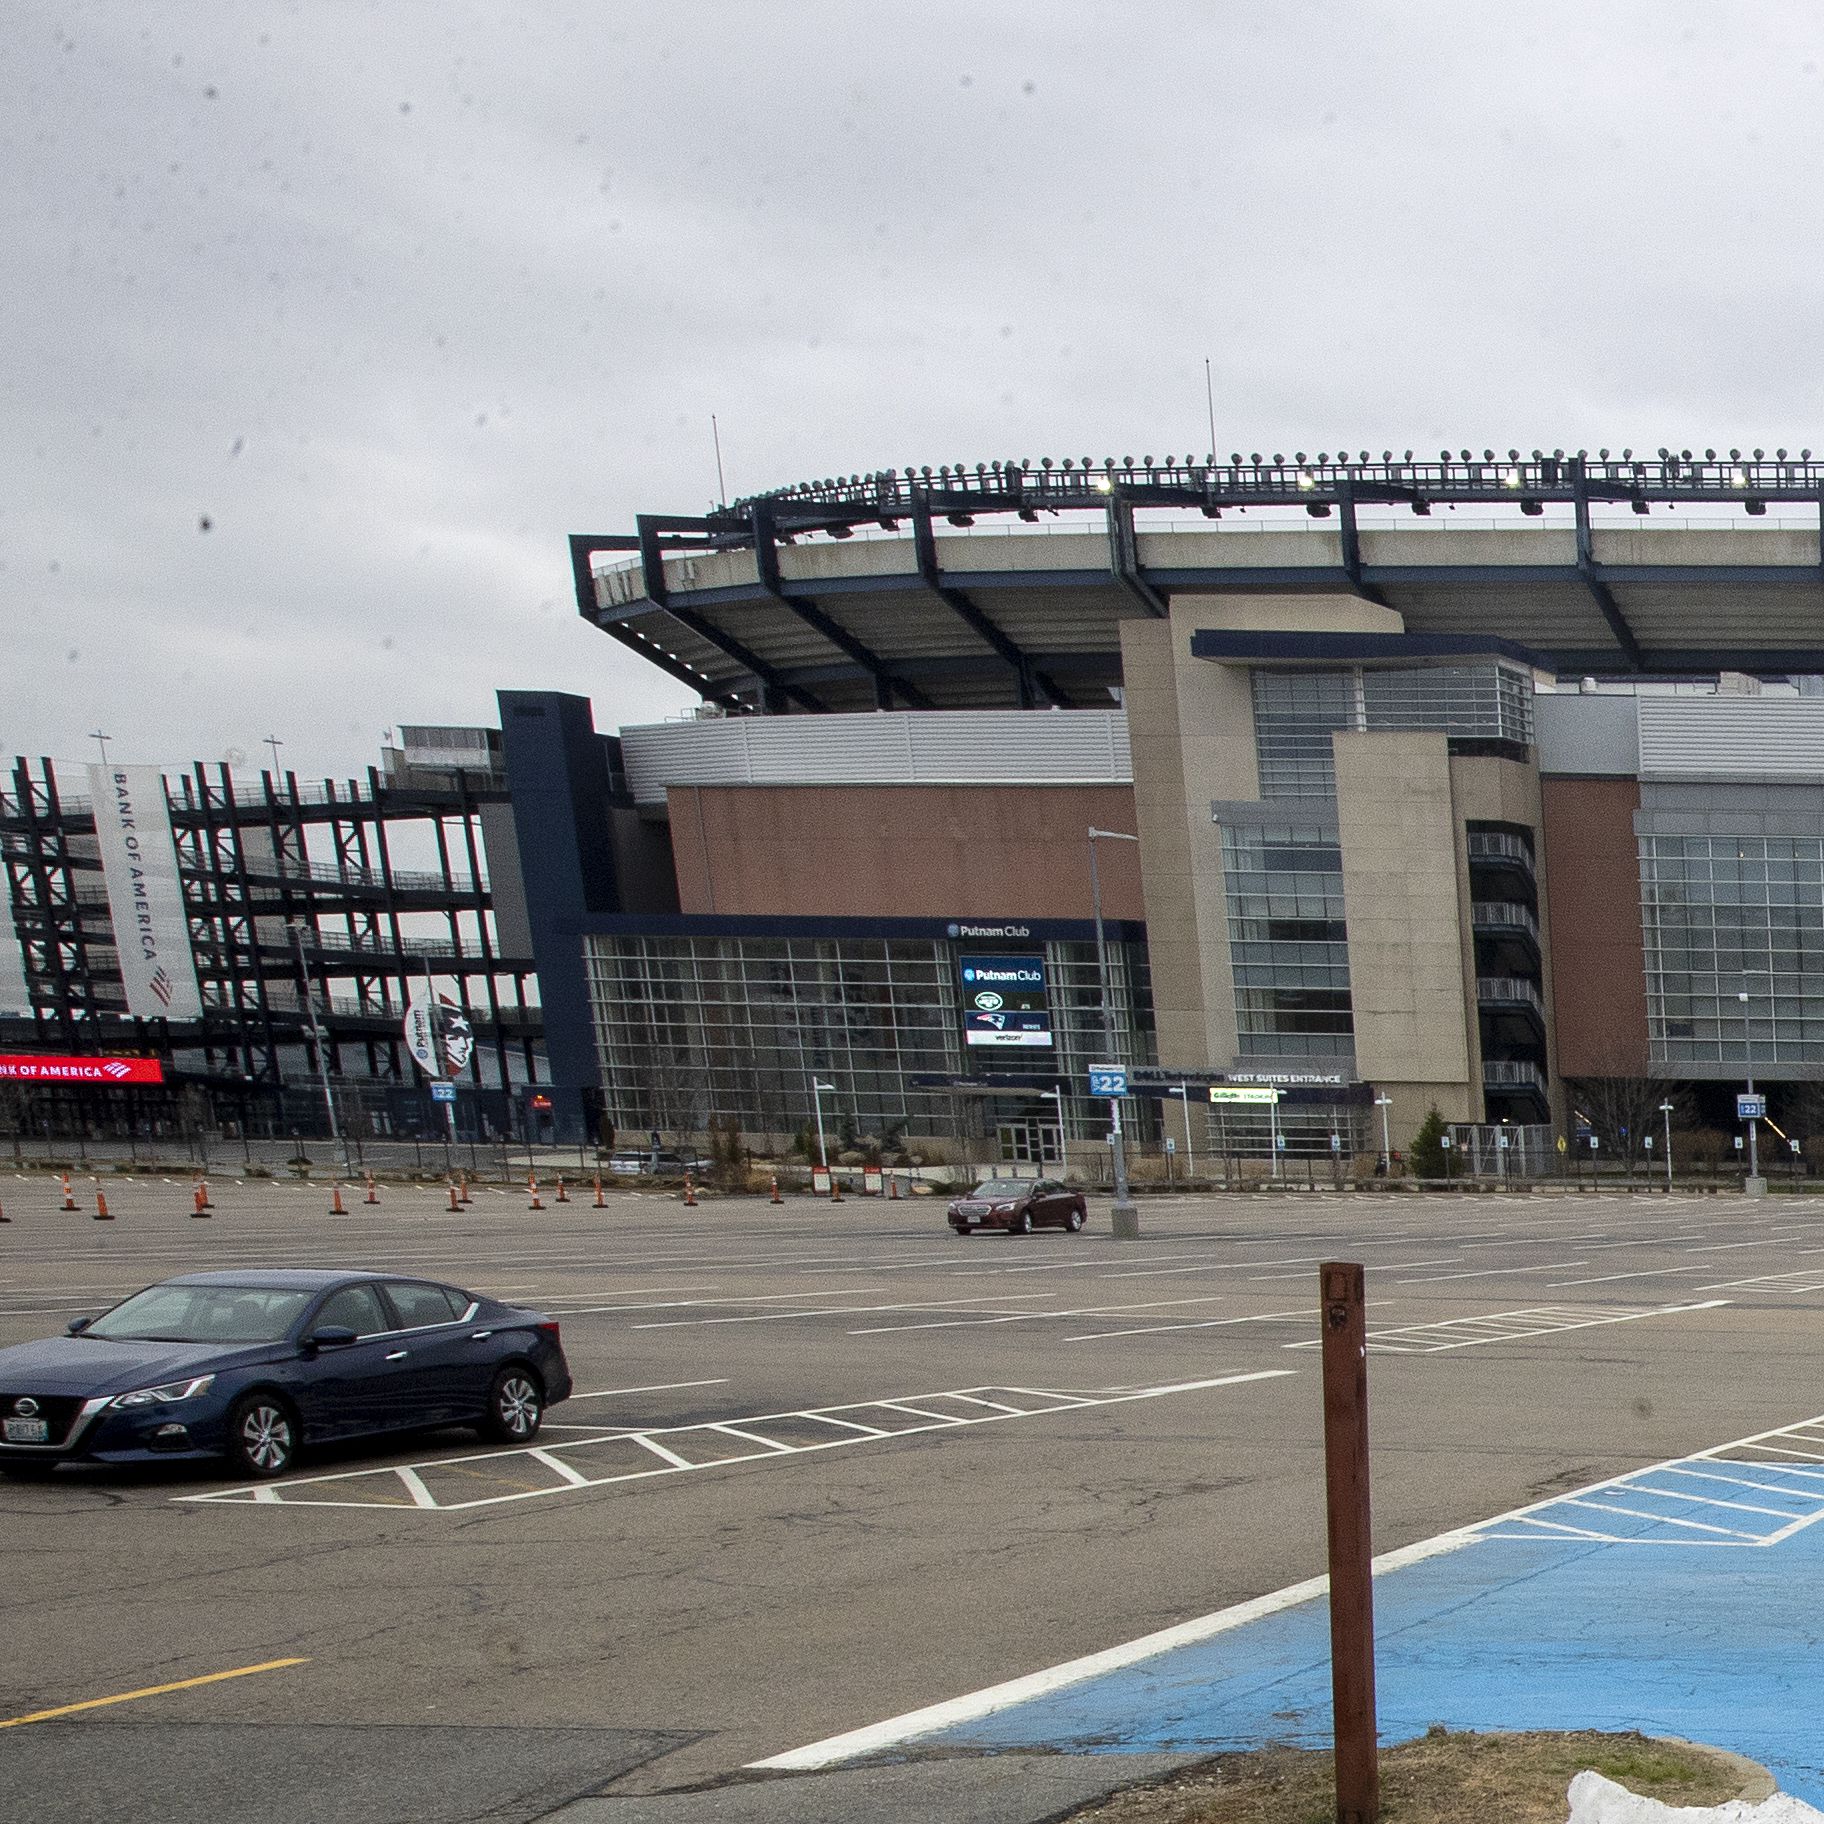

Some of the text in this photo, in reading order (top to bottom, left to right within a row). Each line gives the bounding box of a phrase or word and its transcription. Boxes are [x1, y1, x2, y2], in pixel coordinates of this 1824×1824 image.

[114, 773, 158, 961] BANK OF AMERICA
[960, 926, 1030, 937] Putnam Club
[976, 969, 1041, 981] Putnam Club
[20, 1065, 37, 1076] OF
[40, 1066, 102, 1077] AMERICA
[1100, 1076, 1125, 1092] 22
[1228, 1074, 1254, 1082] WEST
[1256, 1074, 1289, 1083] SUITES
[1290, 1074, 1341, 1083] ENTRANCE
[1744, 1104, 1757, 1114] 22
